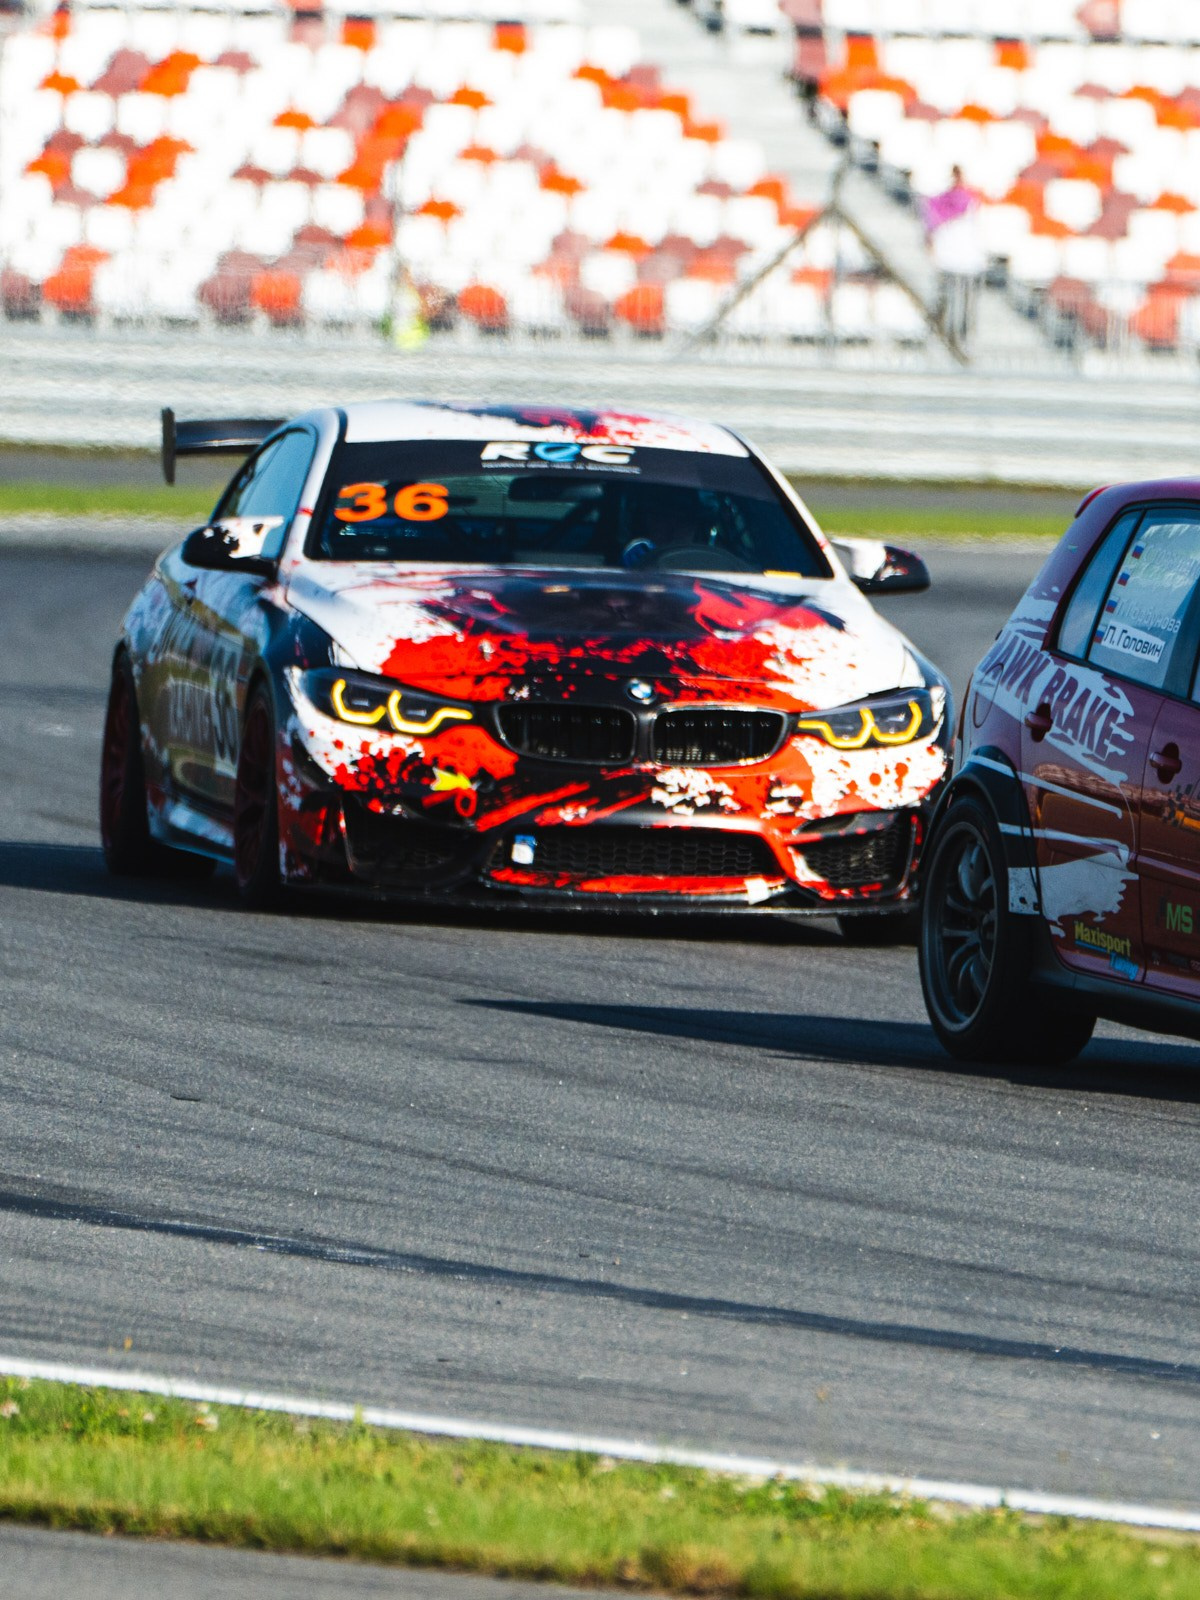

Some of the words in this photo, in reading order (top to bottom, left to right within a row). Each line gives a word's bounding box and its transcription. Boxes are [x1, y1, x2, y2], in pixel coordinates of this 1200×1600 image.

[334, 482, 449, 522] 36
[1038, 667, 1121, 761] BRAKE
[1074, 921, 1132, 957] Maxisport
